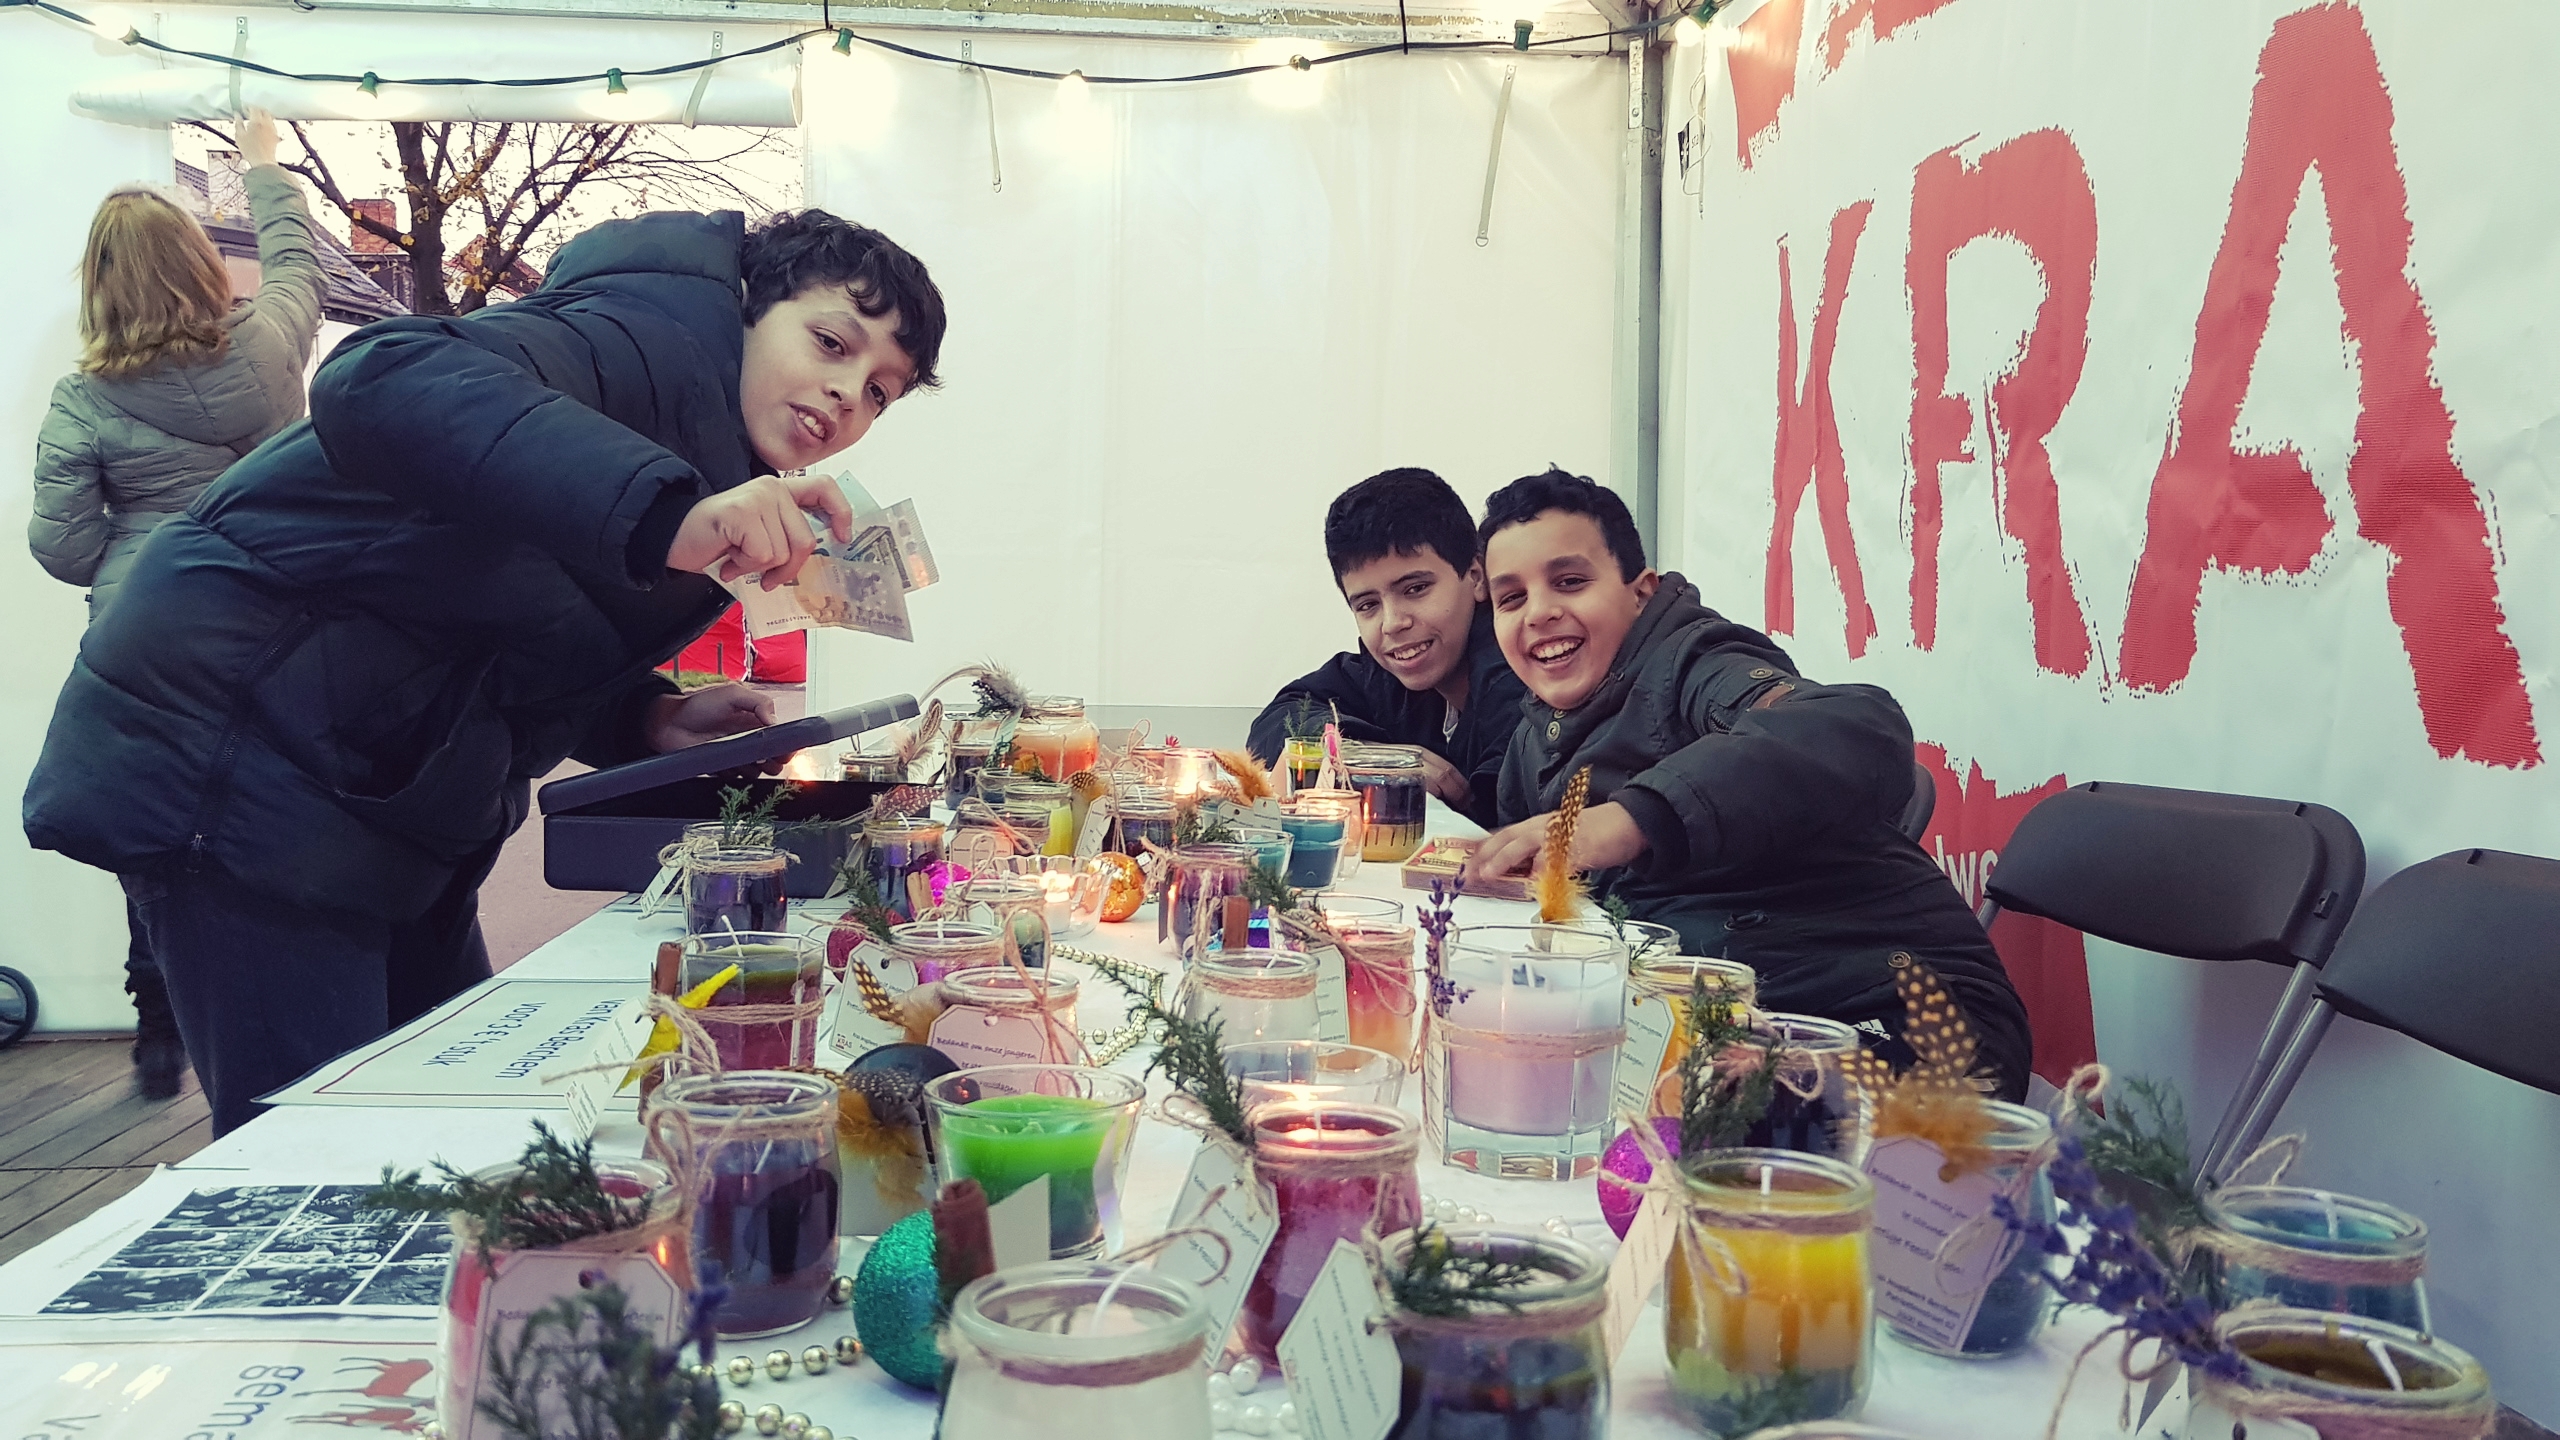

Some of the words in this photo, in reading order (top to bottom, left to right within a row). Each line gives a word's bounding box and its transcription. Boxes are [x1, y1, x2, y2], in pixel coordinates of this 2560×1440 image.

[500, 1002, 547, 1022] voor
[586, 999, 625, 1015] van
[559, 1016, 611, 1035] Kras
[422, 1046, 477, 1066] stuk
[495, 1036, 585, 1078] Berchem
[936, 1037, 969, 1049] Bedankt
[1003, 1047, 1038, 1059] jongeren
